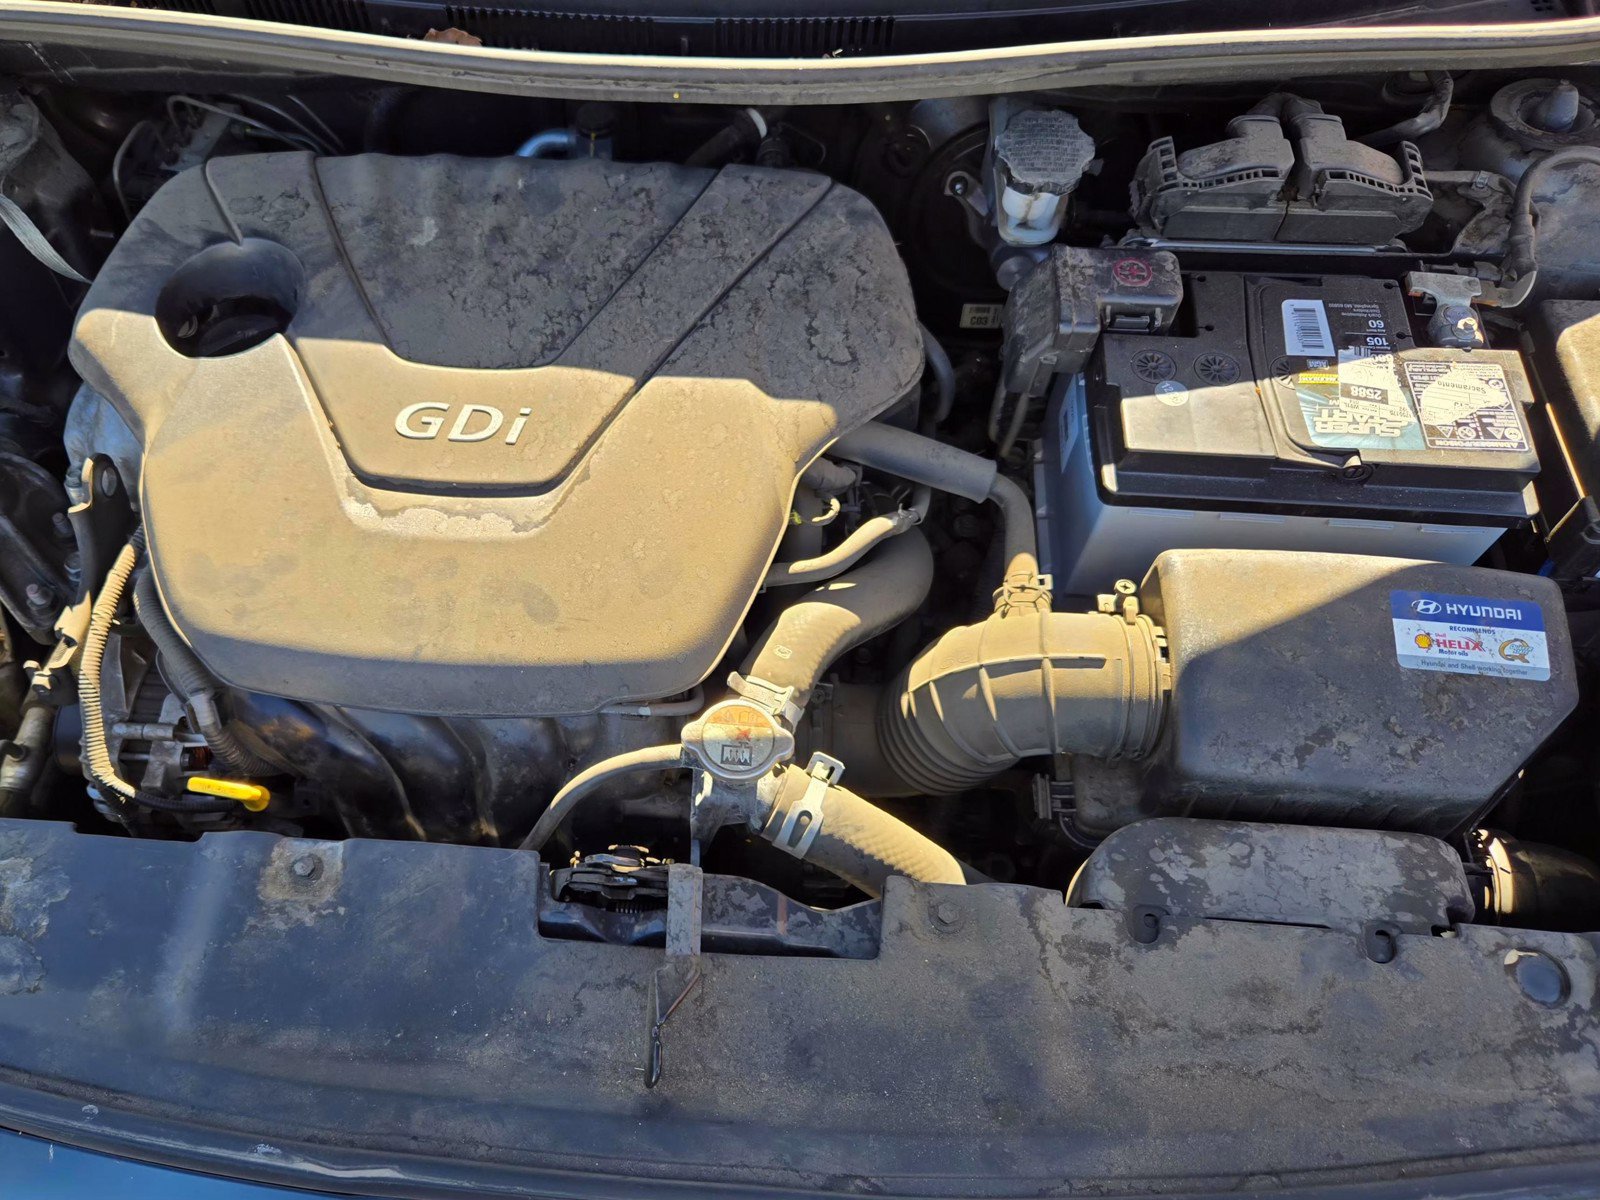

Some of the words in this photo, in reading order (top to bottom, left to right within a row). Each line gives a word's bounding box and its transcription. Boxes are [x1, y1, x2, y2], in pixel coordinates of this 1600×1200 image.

[1368, 320, 1384, 328] 60
[1366, 337, 1389, 346] 105
[1308, 360, 1327, 368] AGM
[1350, 386, 1382, 400] 2588
[1437, 380, 1487, 395] Sacramento
[394, 402, 533, 445] GDi
[1315, 421, 1401, 437] SUPER
[1446, 603, 1522, 621] HYUNDAI
[1449, 626, 1496, 635] RECOMMENDS
[1436, 638, 1486, 652] HELIX
[1421, 659, 1446, 668] Hyundai
[1460, 663, 1477, 671] Shell
[1477, 665, 1500, 674] working
[1502, 668, 1528, 676] together
